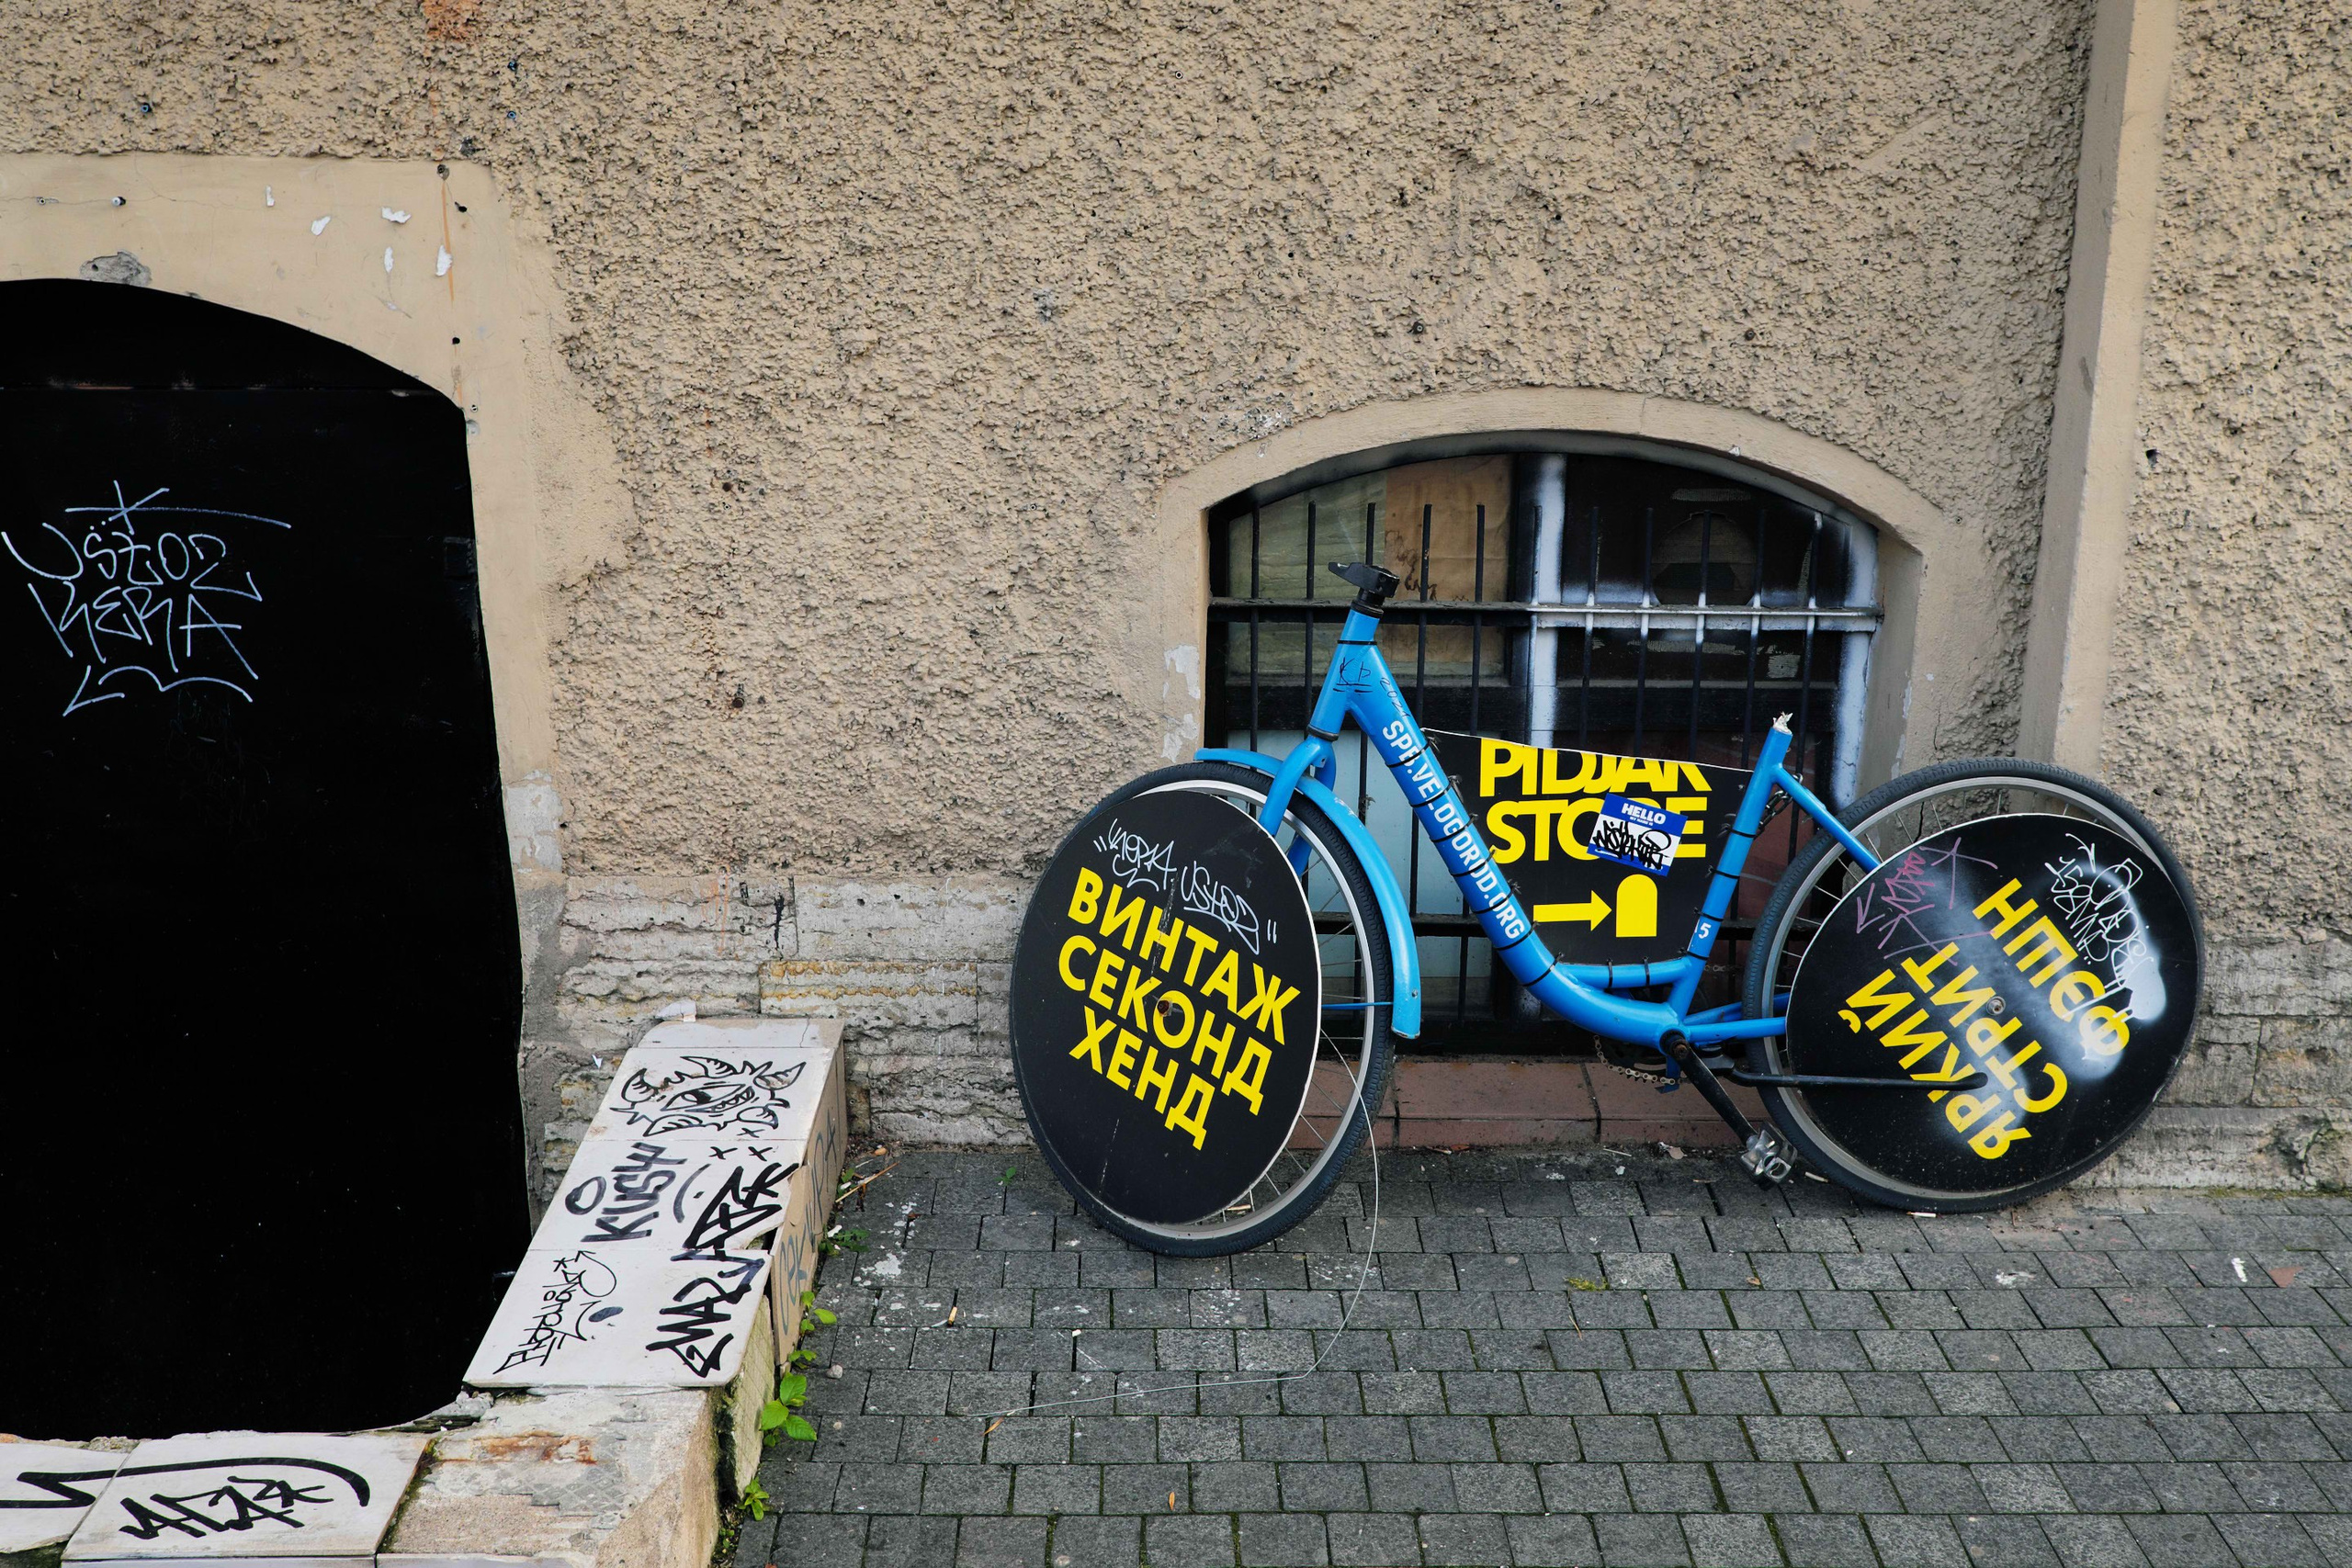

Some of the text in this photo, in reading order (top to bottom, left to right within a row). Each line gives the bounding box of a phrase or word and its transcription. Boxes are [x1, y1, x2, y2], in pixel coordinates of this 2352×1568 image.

[1486, 796, 1708, 864] STOE
[1621, 802, 1667, 825] HELLO
[1067, 866, 1301, 1045] ВИНТАЖ
[1698, 922, 1712, 940] 5
[1972, 877, 2131, 1055] ФЭШН
[1057, 934, 1273, 1116] СЕКОНД
[1069, 1005, 1216, 1151] ХЕНД
[1838, 968, 2032, 1159] ЯРКИЙ
[1901, 942, 2067, 1113] СТРИТ
